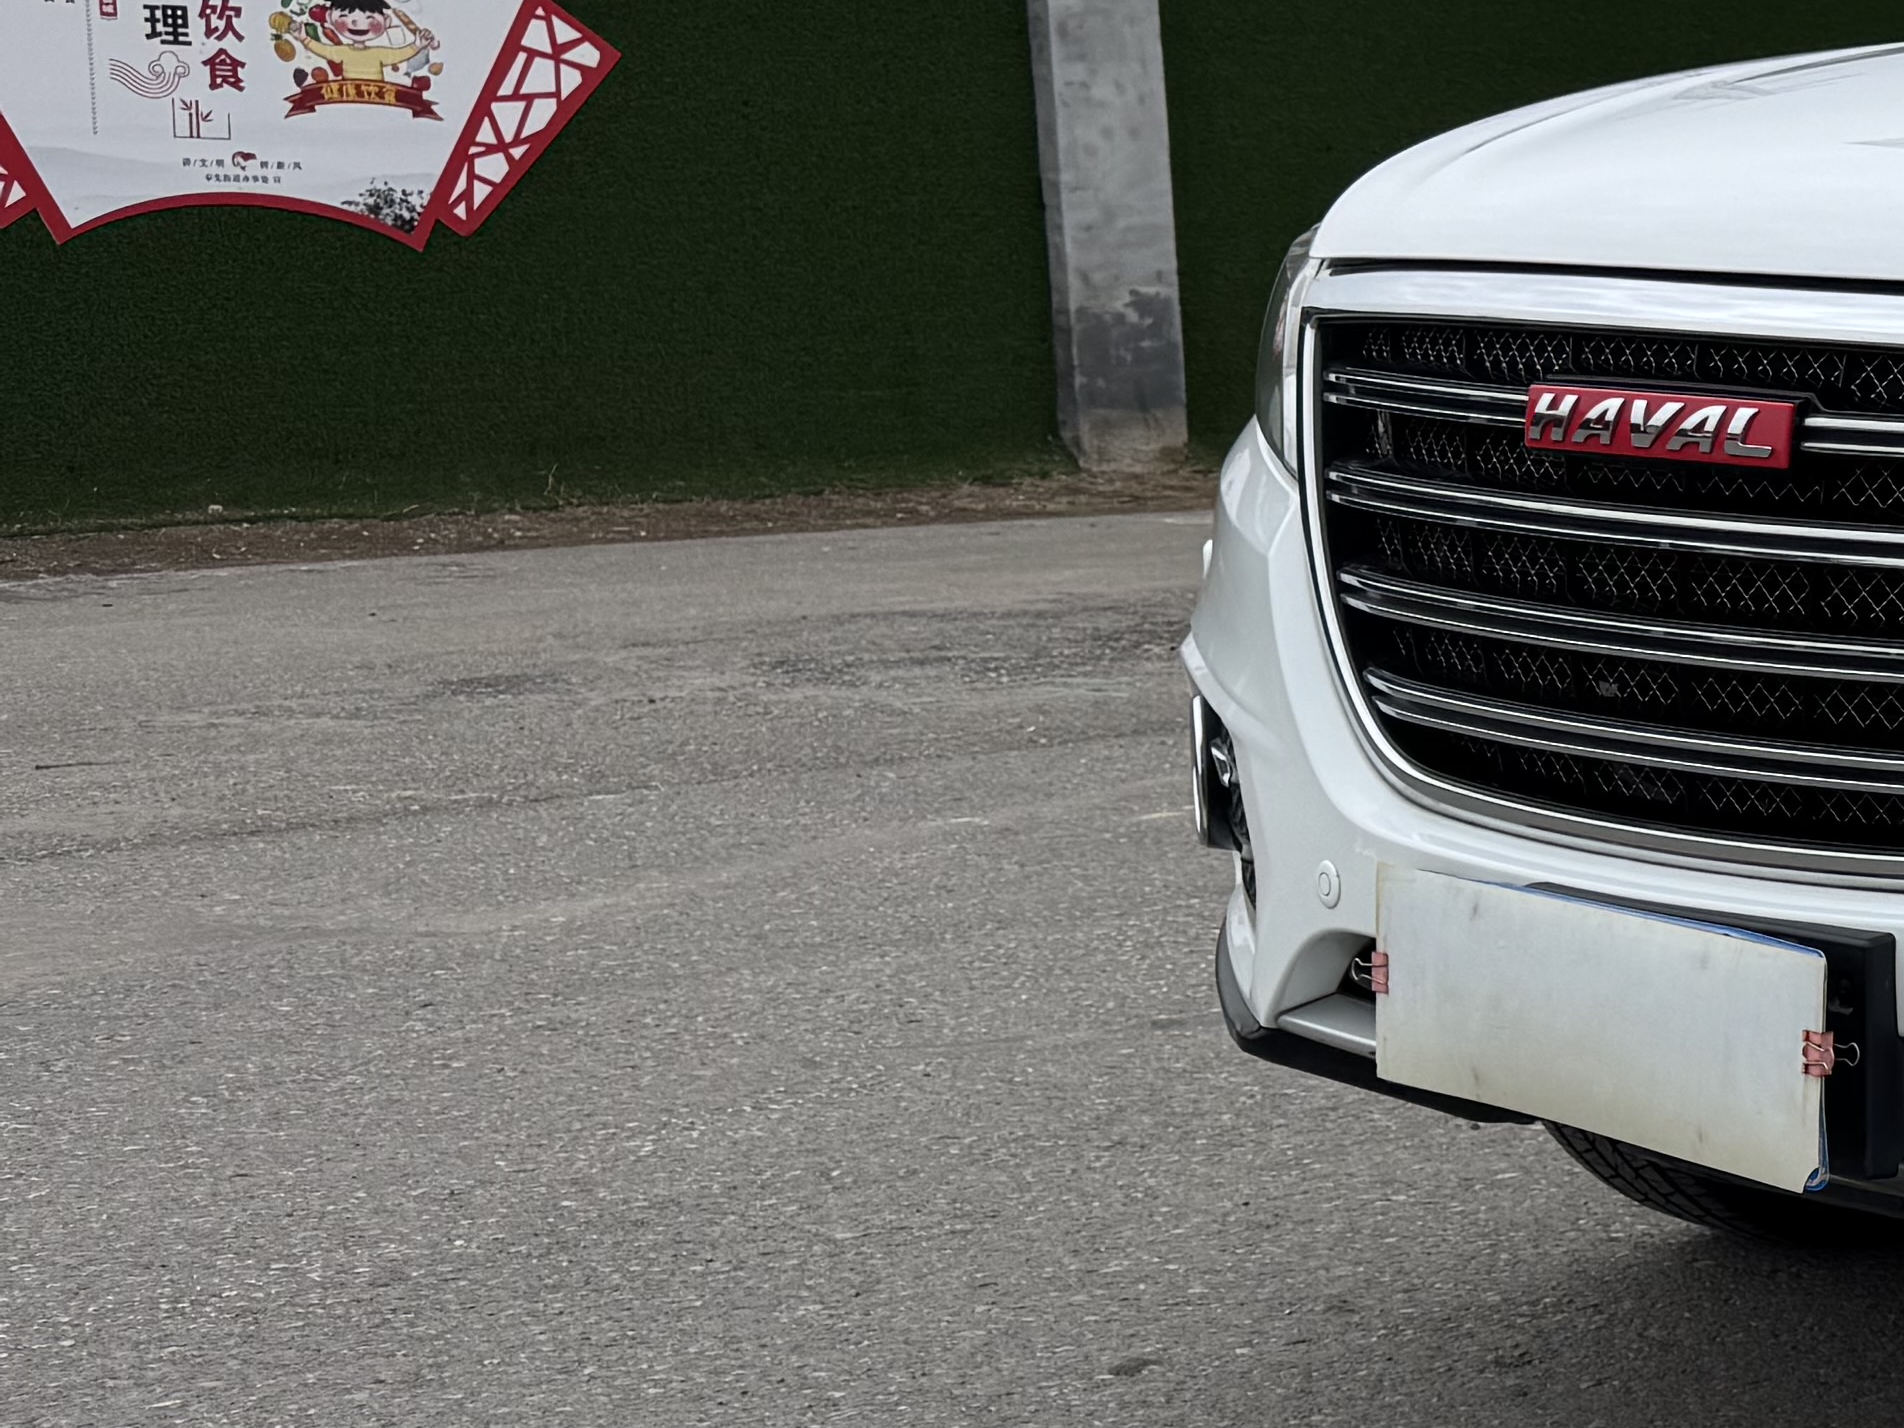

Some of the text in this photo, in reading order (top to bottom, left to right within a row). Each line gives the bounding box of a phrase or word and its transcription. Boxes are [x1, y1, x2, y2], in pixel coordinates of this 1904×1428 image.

[320, 83, 397, 104] 健康饮食
[1529, 392, 1772, 458] HAVAL
